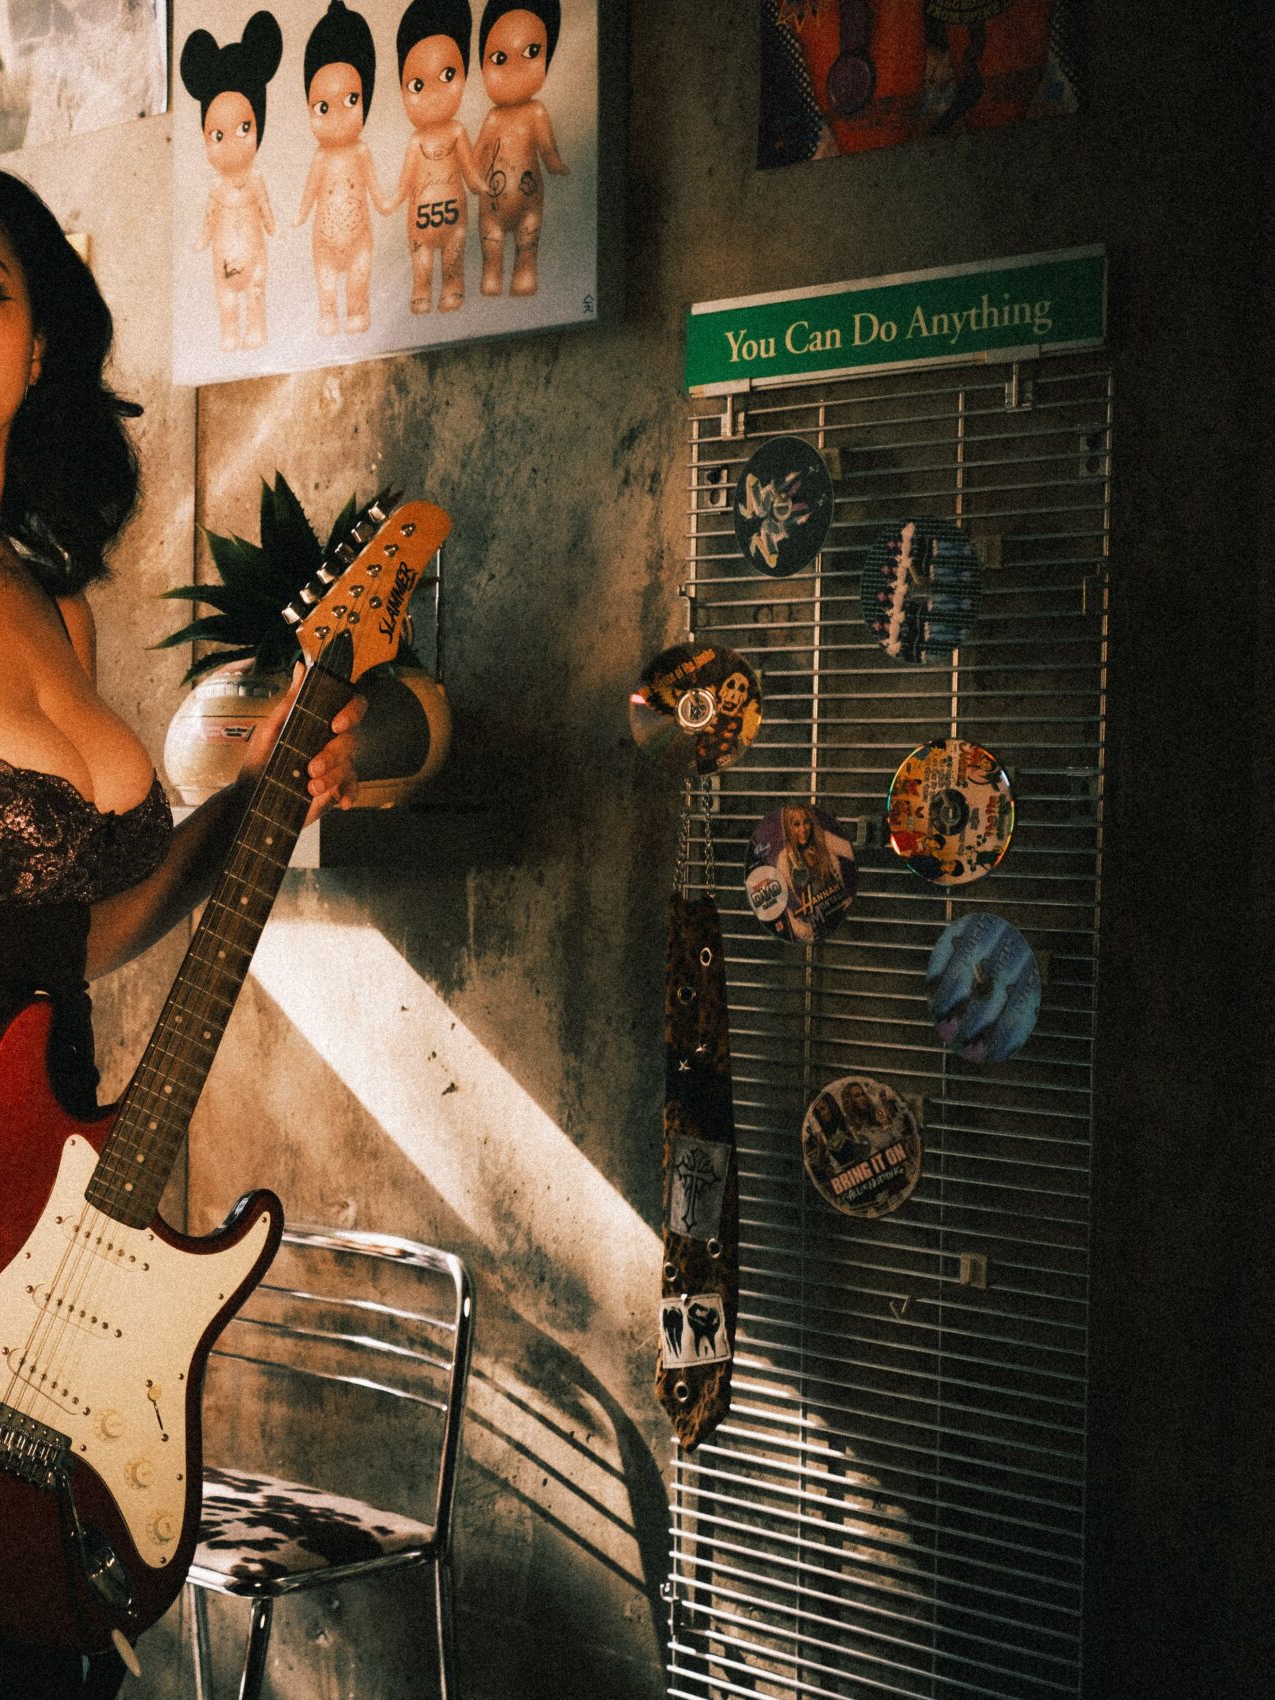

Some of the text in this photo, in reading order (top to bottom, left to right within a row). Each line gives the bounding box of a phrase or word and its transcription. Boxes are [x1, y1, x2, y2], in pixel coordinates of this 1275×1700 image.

[415, 199, 460, 230] 555
[725, 293, 1055, 363] You Can Do Anything
[379, 561, 414, 645] SLAMMER
[830, 1161, 873, 1195] BRING
[870, 1153, 886, 1174] IT
[885, 1143, 907, 1166] ON
